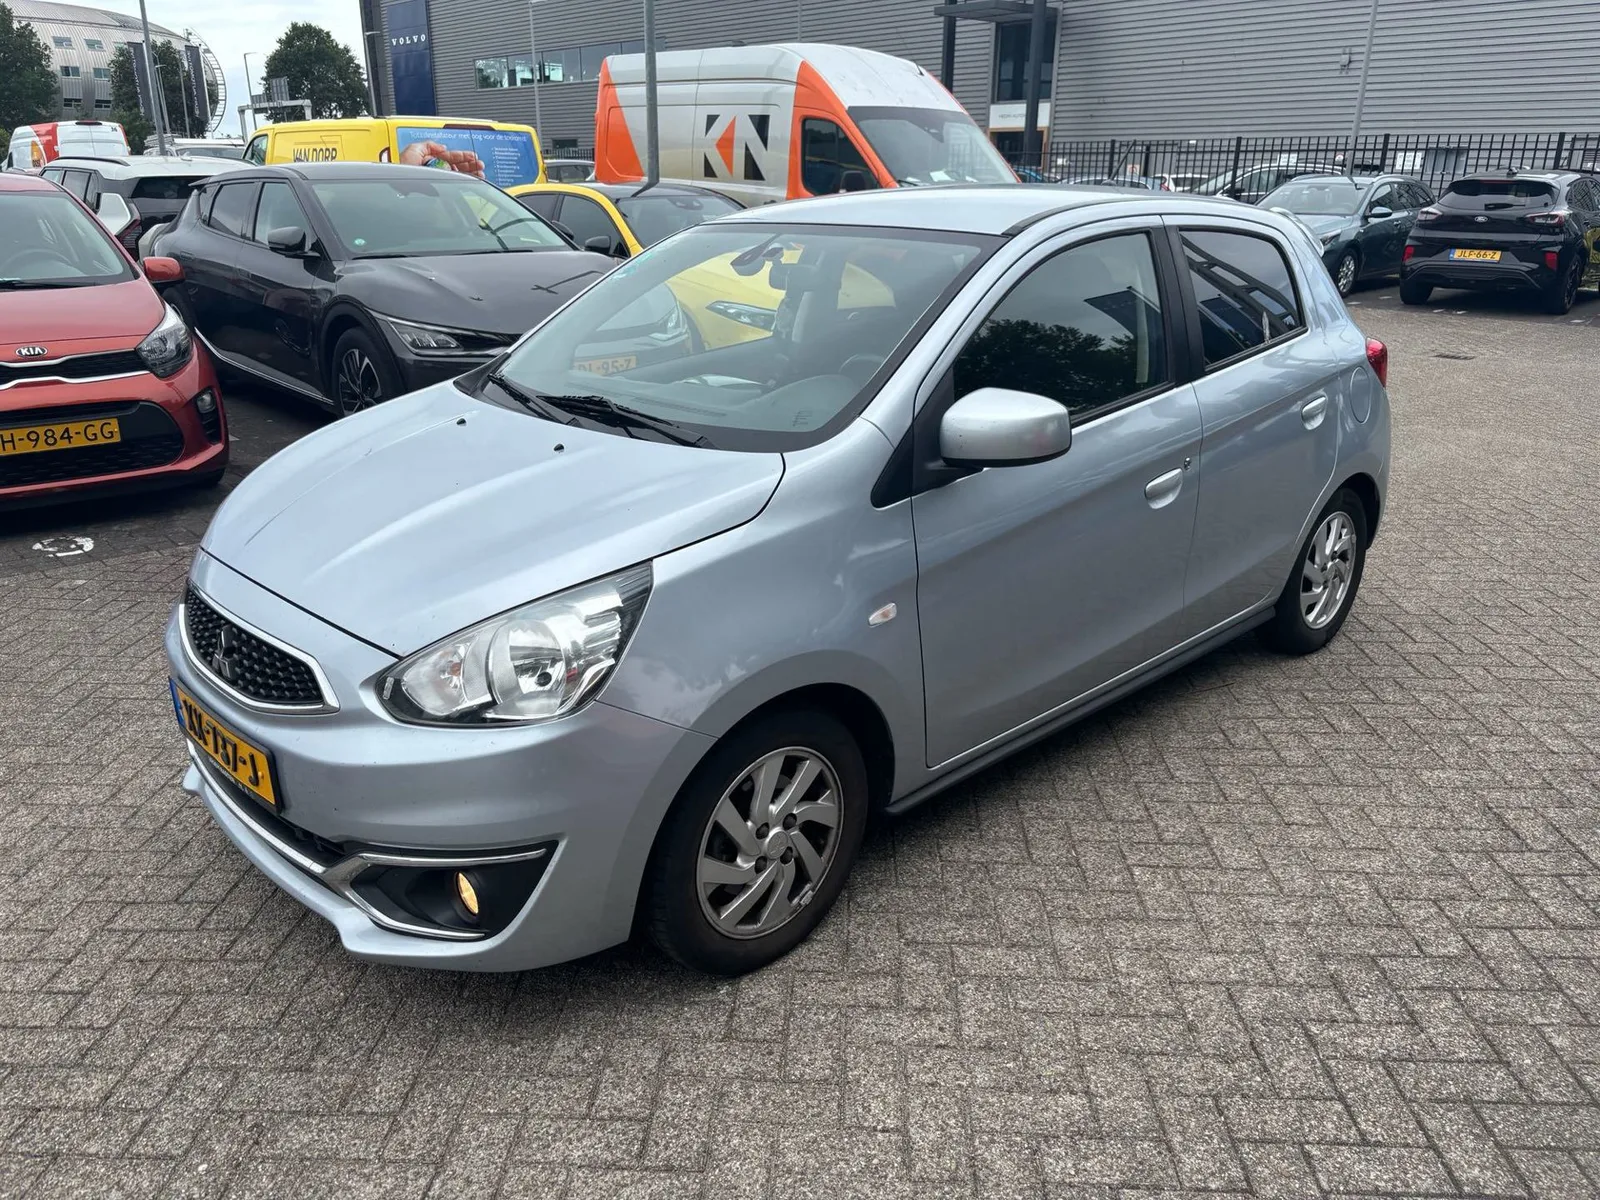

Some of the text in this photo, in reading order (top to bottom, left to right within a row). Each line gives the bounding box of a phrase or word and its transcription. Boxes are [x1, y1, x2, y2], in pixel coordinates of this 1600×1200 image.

[391, 34, 426, 46] VOLVO
[293, 147, 338, 162] VAN DORP
[1457, 250, 1497, 259] JLF-66-Z
[20, 347, 44, 356] KIA
[0, 422, 115, 452] H-984-GG
